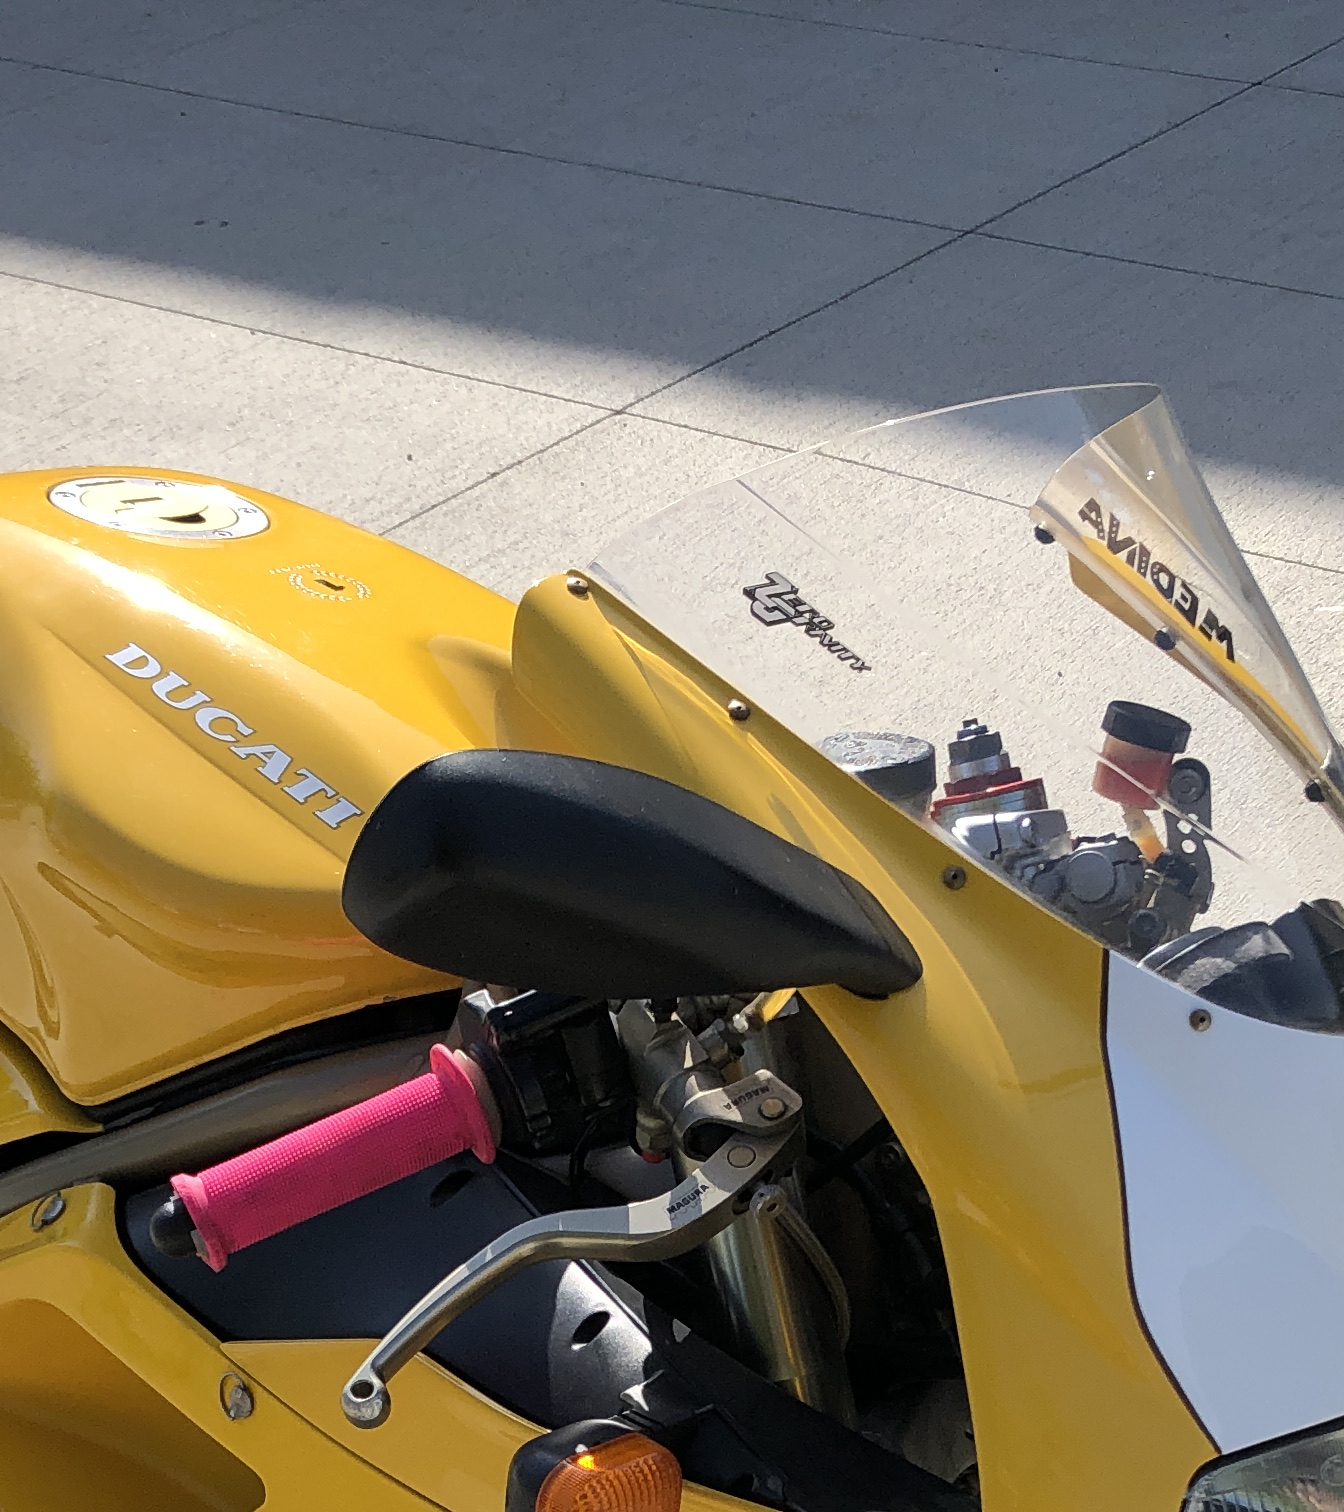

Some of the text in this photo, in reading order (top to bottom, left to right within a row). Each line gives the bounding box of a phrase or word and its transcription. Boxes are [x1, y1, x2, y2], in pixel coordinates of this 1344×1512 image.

[743, 571, 835, 631] ZERO
[750, 598, 872, 673] GRAVITY
[104, 642, 364, 829] DUCATI
[666, 1183, 710, 1215] MAGURA
